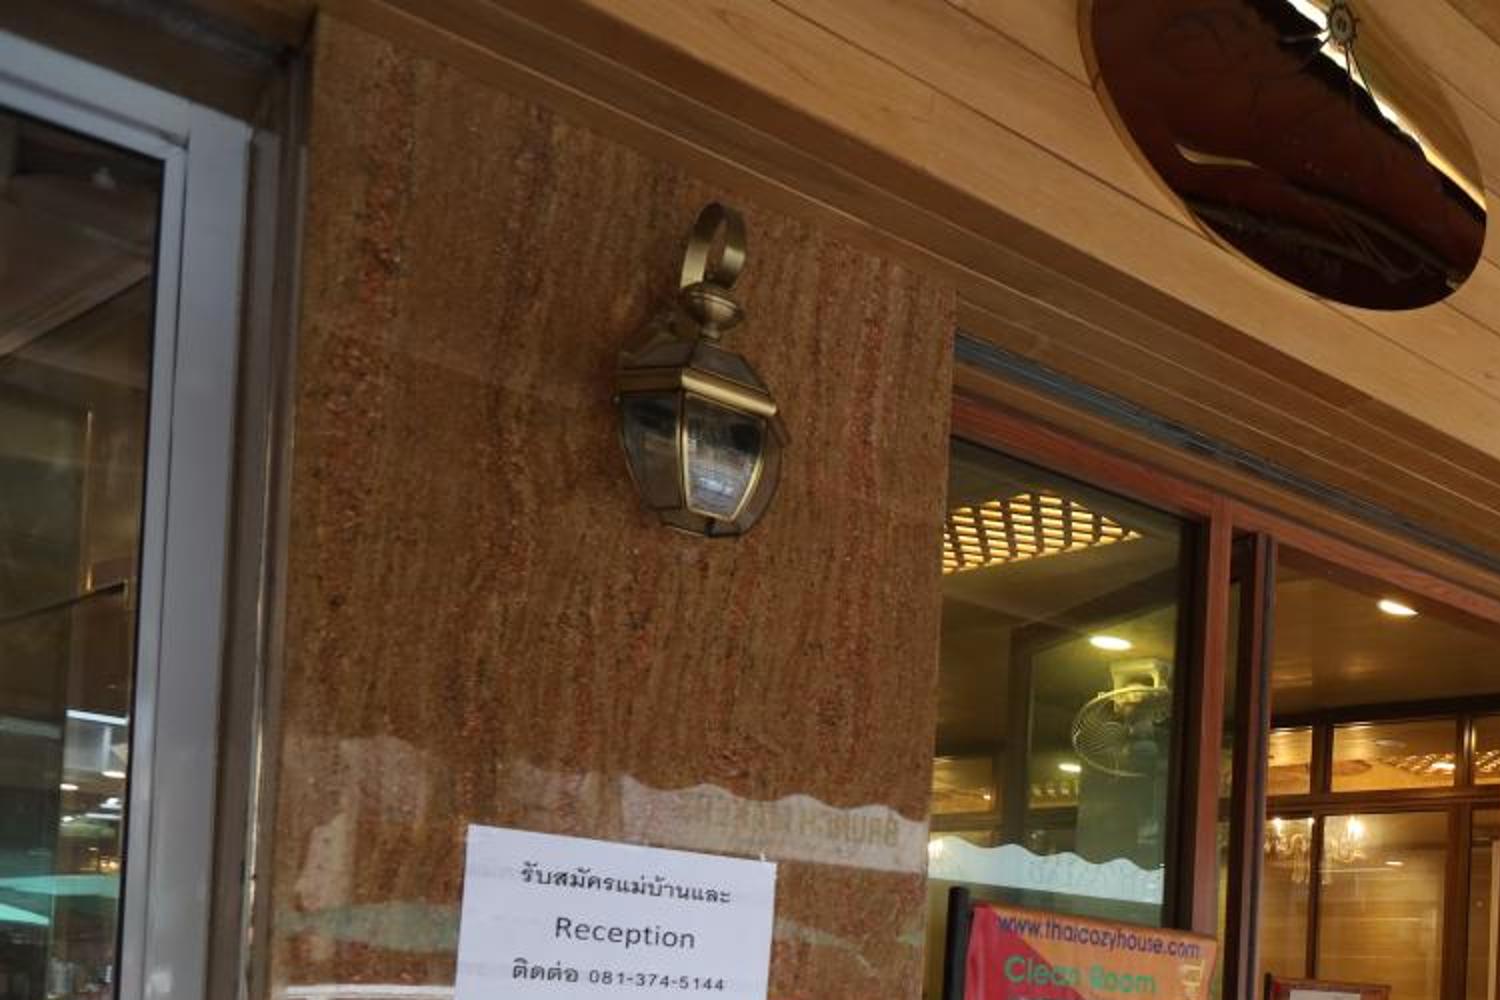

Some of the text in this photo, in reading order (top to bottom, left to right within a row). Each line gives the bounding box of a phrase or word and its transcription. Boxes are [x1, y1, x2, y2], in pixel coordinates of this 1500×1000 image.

[520, 860, 731, 903] รับสมัครแม่บ้านและ
[554, 916, 696, 950] Reception
[996, 914, 1201, 959] www.thaicozyhouse.com
[511, 956, 725, 991] ติดต่อ 081-374-5144
[1003, 954, 1082, 988] Clean
